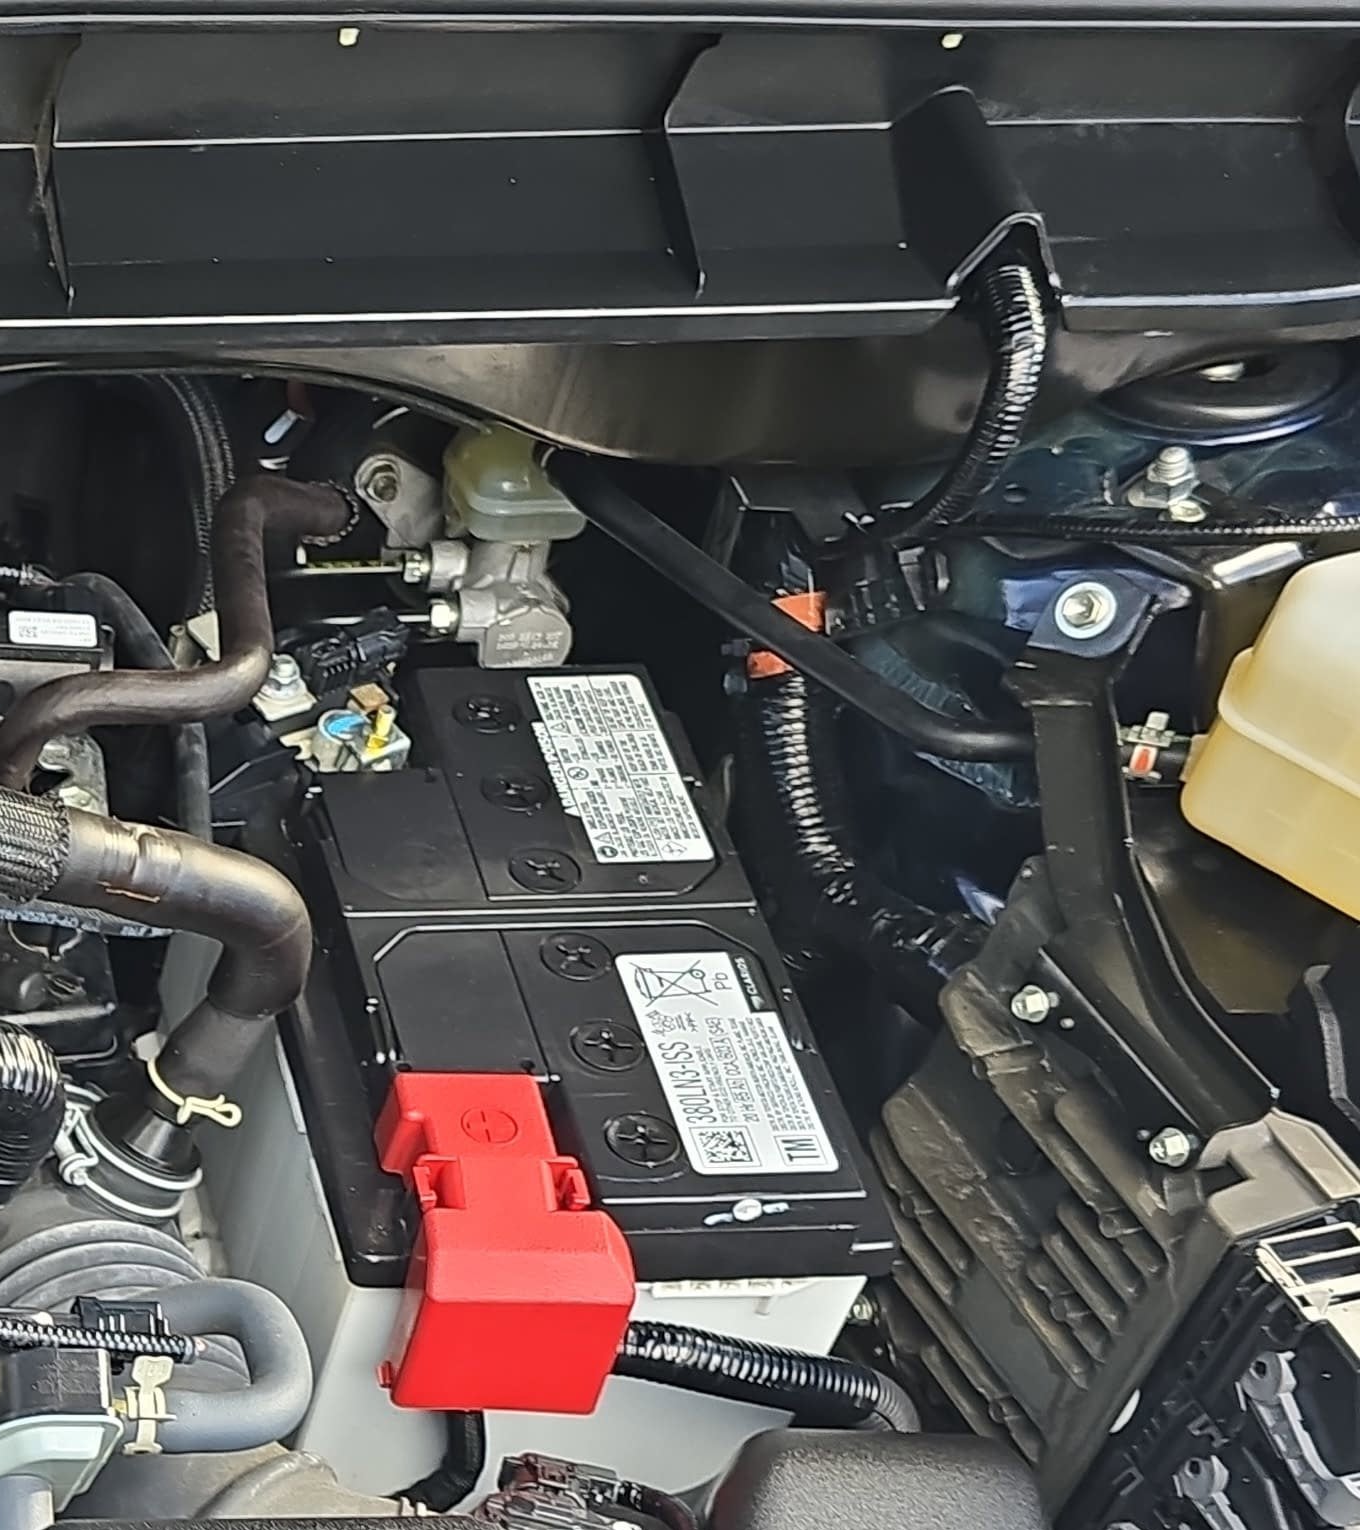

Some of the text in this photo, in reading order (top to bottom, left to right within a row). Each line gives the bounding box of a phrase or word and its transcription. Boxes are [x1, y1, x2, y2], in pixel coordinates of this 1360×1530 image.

[712, 972, 733, 991] Pb
[658, 1041, 717, 1124] 380LN3-ISS
[780, 1138, 821, 1162] TM
